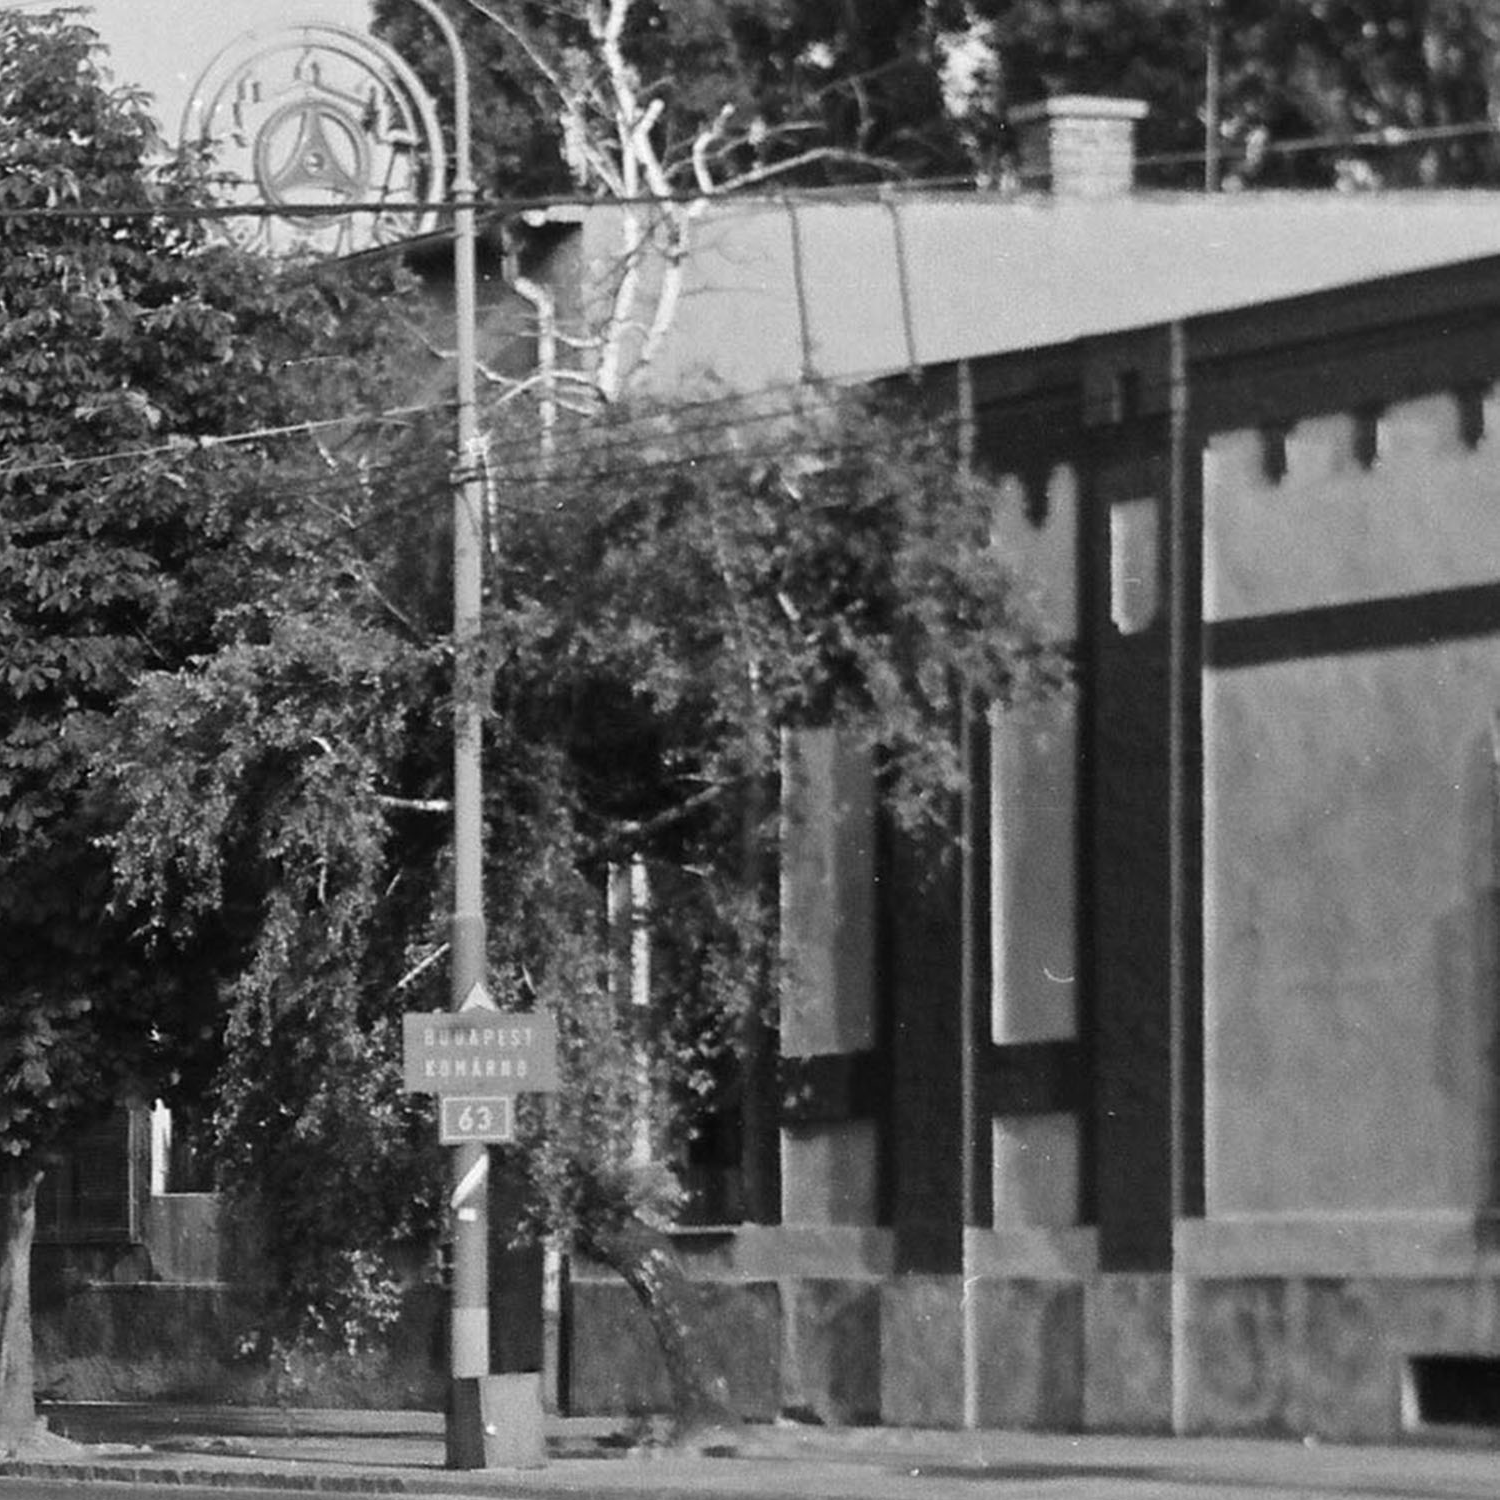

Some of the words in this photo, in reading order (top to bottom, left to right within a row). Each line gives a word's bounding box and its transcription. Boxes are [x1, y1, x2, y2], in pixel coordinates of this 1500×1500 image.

[424, 1028, 532, 1047] BUDAPEST
[425, 1056, 528, 1078] KOMÁRNO
[458, 1105, 493, 1131] 63
